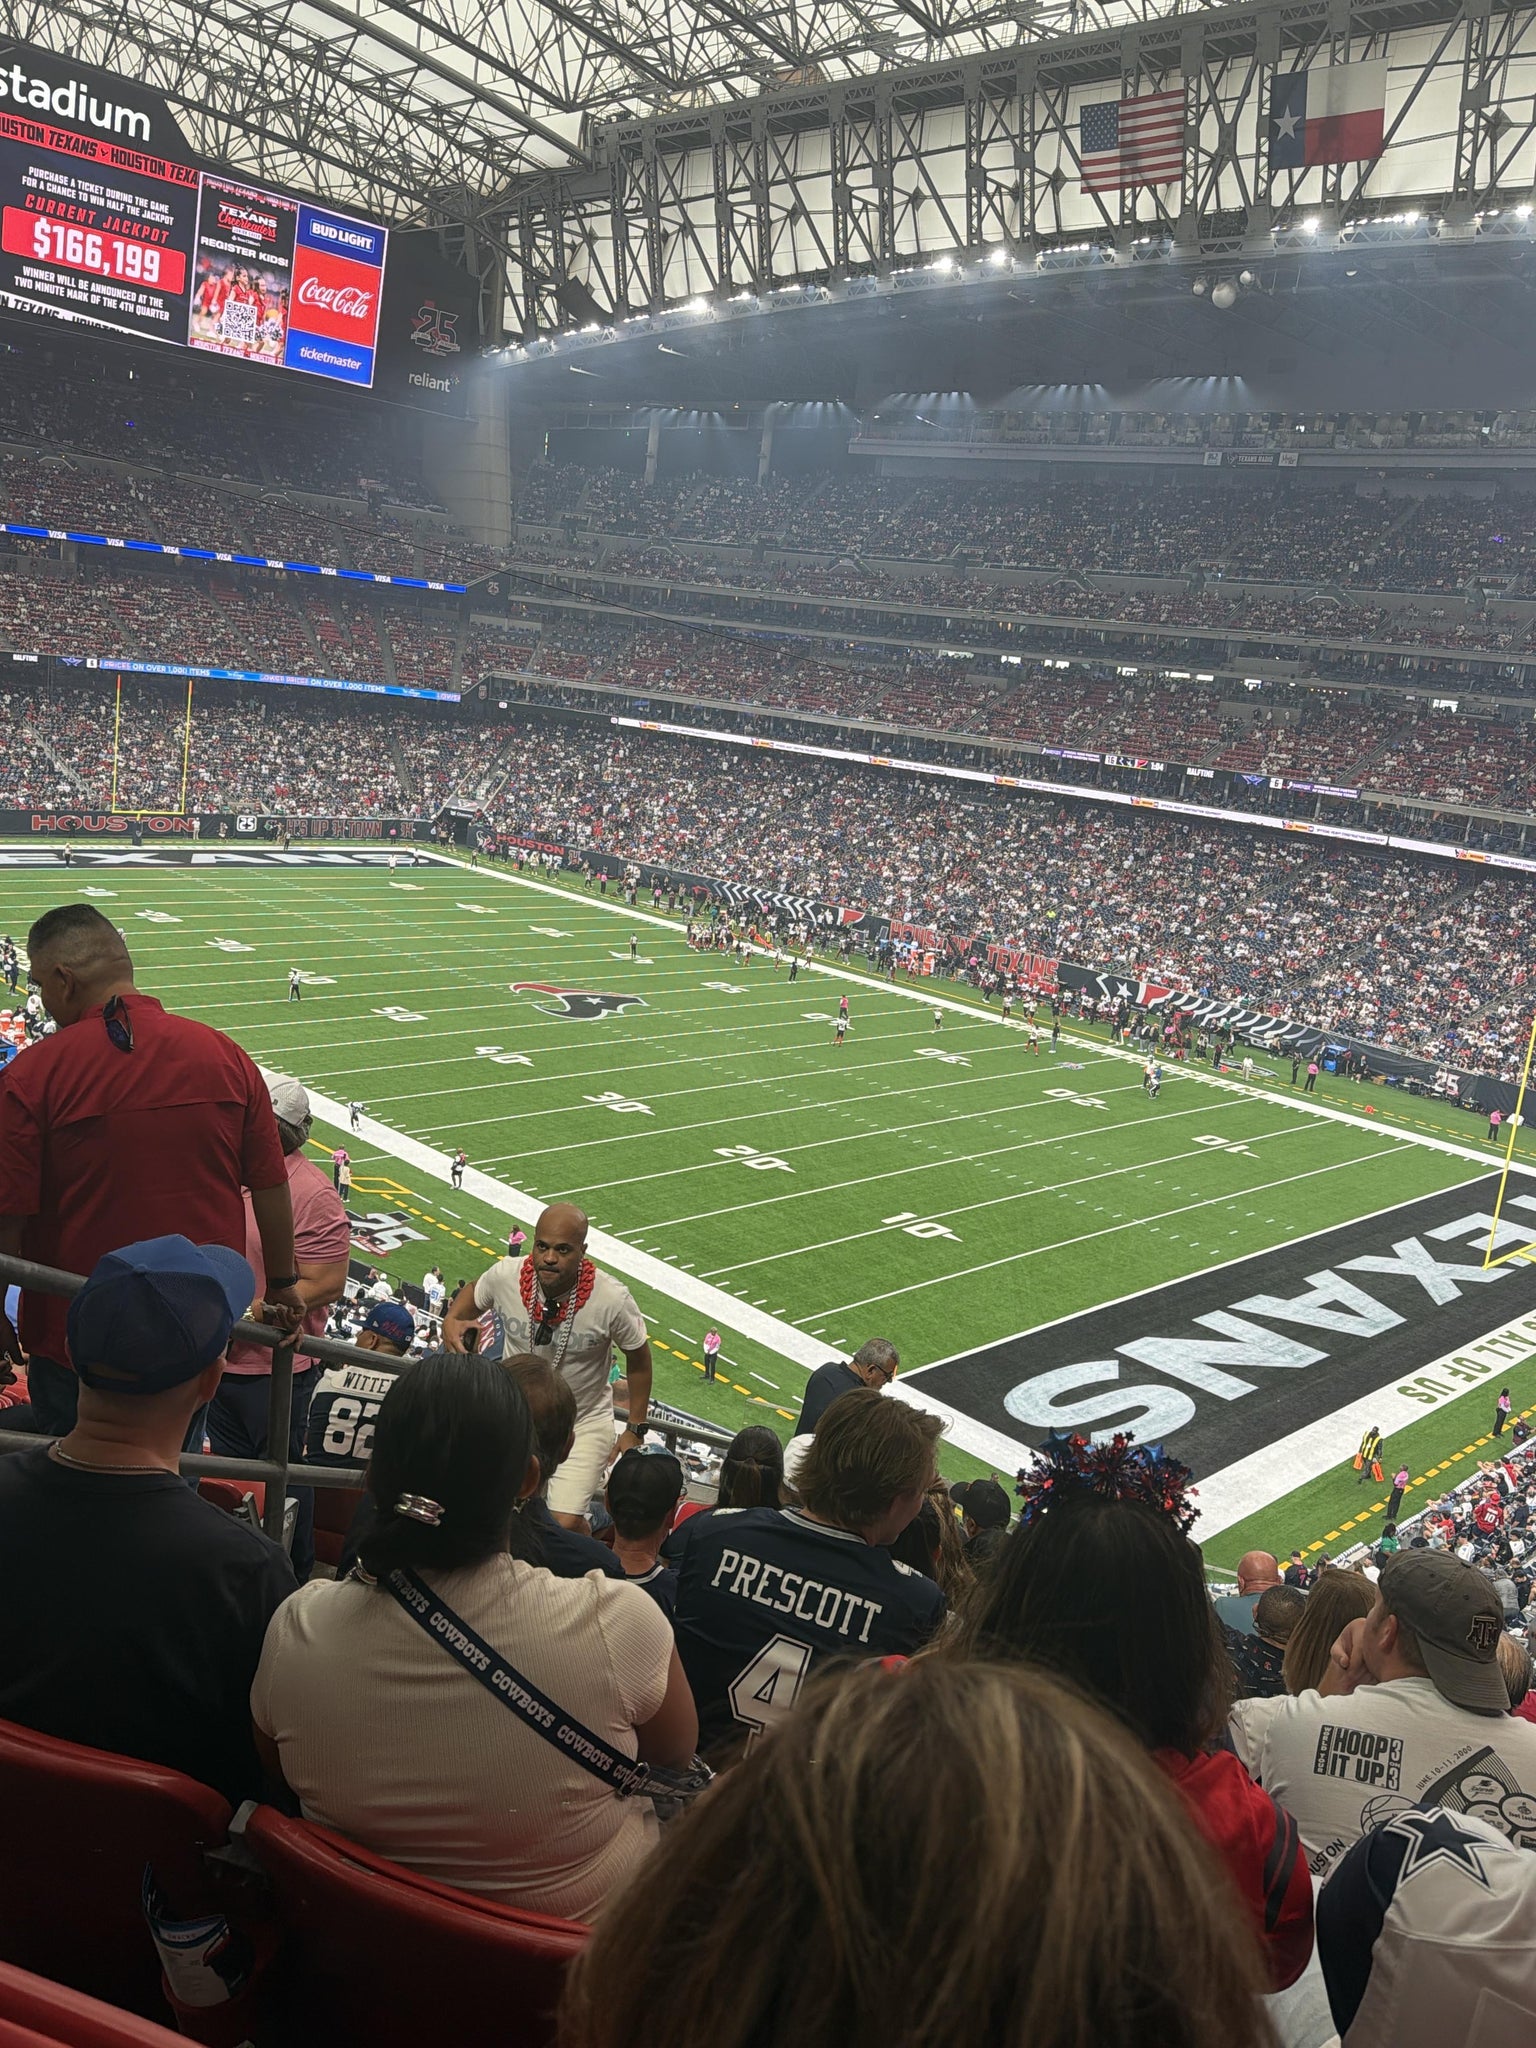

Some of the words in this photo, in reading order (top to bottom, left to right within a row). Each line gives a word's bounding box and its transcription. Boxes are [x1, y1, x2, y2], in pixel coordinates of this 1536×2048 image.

[0, 116, 44, 143] USTON
[49, 130, 98, 157] TEXANS
[110, 149, 166, 176] HOUSTON
[170, 164, 198, 185] TEXA
[22, 176, 38, 190] FOR
[39, 180, 44, 191] A
[46, 182, 76, 200] CHANCE
[78, 191, 88, 202] TO
[90, 194, 104, 207] WIN
[106, 198, 126, 212] HALF
[126, 204, 140, 216] THE
[142, 208, 174, 226] JACKPOT
[28, 166, 68, 186] PURCHASE
[70, 178, 76, 188] A
[77, 180, 104, 194] TICKET
[106, 187, 133, 204] DURING
[135, 194, 148, 207] THE
[150, 198, 170, 214] GAME
[24, 193, 96, 224] CURRENT
[102, 214, 170, 244] JACKPOT
[218, 211, 276, 238] Cheerleaders
[219, 204, 277, 228] TEXANS
[33, 217, 160, 283] $166,199
[312, 222, 338, 240] BUD
[338, 228, 372, 250] LIGHT
[201, 236, 256, 259] REGISTER
[259, 252, 288, 268] KIDS!
[14, 276, 33, 290] TWO
[34, 280, 64, 298] MINUTE
[66, 287, 89, 303] MARK
[90, 293, 100, 305] OF
[102, 296, 118, 310] THE
[119, 298, 134, 314] 4TH
[136, 304, 170, 322] QUARTER
[22, 266, 55, 283] WINNER
[57, 273, 76, 288] WILL
[78, 278, 89, 290] BE
[90, 281, 136, 302] ANNOUNCED
[138, 292, 148, 304] AT
[150, 295, 164, 308] THE
[298, 277, 374, 319] Coca-Cola
[416, 306, 459, 352] 25
[300, 346, 362, 370] ticketmaster
[408, 372, 450, 392] reliant
[48, 530, 67, 540] VISA
[106, 538, 124, 548] VISA
[162, 545, 180, 554] VISA
[216, 552, 232, 562] VISA
[267, 560, 284, 569] VISA
[320, 567, 337, 576] VISA
[374, 574, 391, 584] VISA
[428, 582, 444, 591] VISA
[12, 654, 38, 662] HALFTIME
[168, 668, 188, 676] 1,000
[190, 668, 210, 676] ITEMS
[324, 681, 342, 689] OVER
[344, 683, 364, 691] 1,000
[365, 685, 386, 693] ITEMS
[1151, 762, 1164, 772] 1:04
[1186, 767, 1214, 778] HALFTIME
[32, 814, 194, 832] HOUSTON
[240, 818, 256, 830] 25
[311, 820, 328, 836] UP
[348, 821, 382, 837] TOWN
[986, 945, 1060, 976] TEXANS
[582, 1091, 651, 1113] 30
[713, 1145, 791, 1170] 20
[881, 1212, 954, 1239] 10
[1470, 1329, 1533, 1360] ALL
[343, 1372, 396, 1394] WITTE
[1434, 1356, 1494, 1384] OF
[1396, 1375, 1456, 1404] US
[1484, 1512, 1496, 1524] 10
[711, 1549, 882, 1643] PRESCOTT
[390, 1568, 430, 1614] COWBOYS
[429, 1611, 491, 1672] COWBOYS
[492, 1669, 556, 1730] COWBOYS
[556, 1724, 614, 1772] COWBOYS
[728, 1633, 814, 1758] 4
[1320, 1726, 1332, 1752] WORLD
[1334, 1728, 1388, 1761] HOOP
[1390, 1740, 1402, 1762] 3
[1316, 1752, 1326, 1774] TOUR
[1330, 1753, 1350, 1778] IT
[1355, 1759, 1384, 1785] UP
[1415, 1774, 1433, 1791] JUNE
[1432, 1756, 1456, 1777] 10-11,
[1453, 1745, 1473, 1761] 2000
[1388, 1768, 1399, 1790] 3
[1308, 1838, 1346, 1875] USTON
